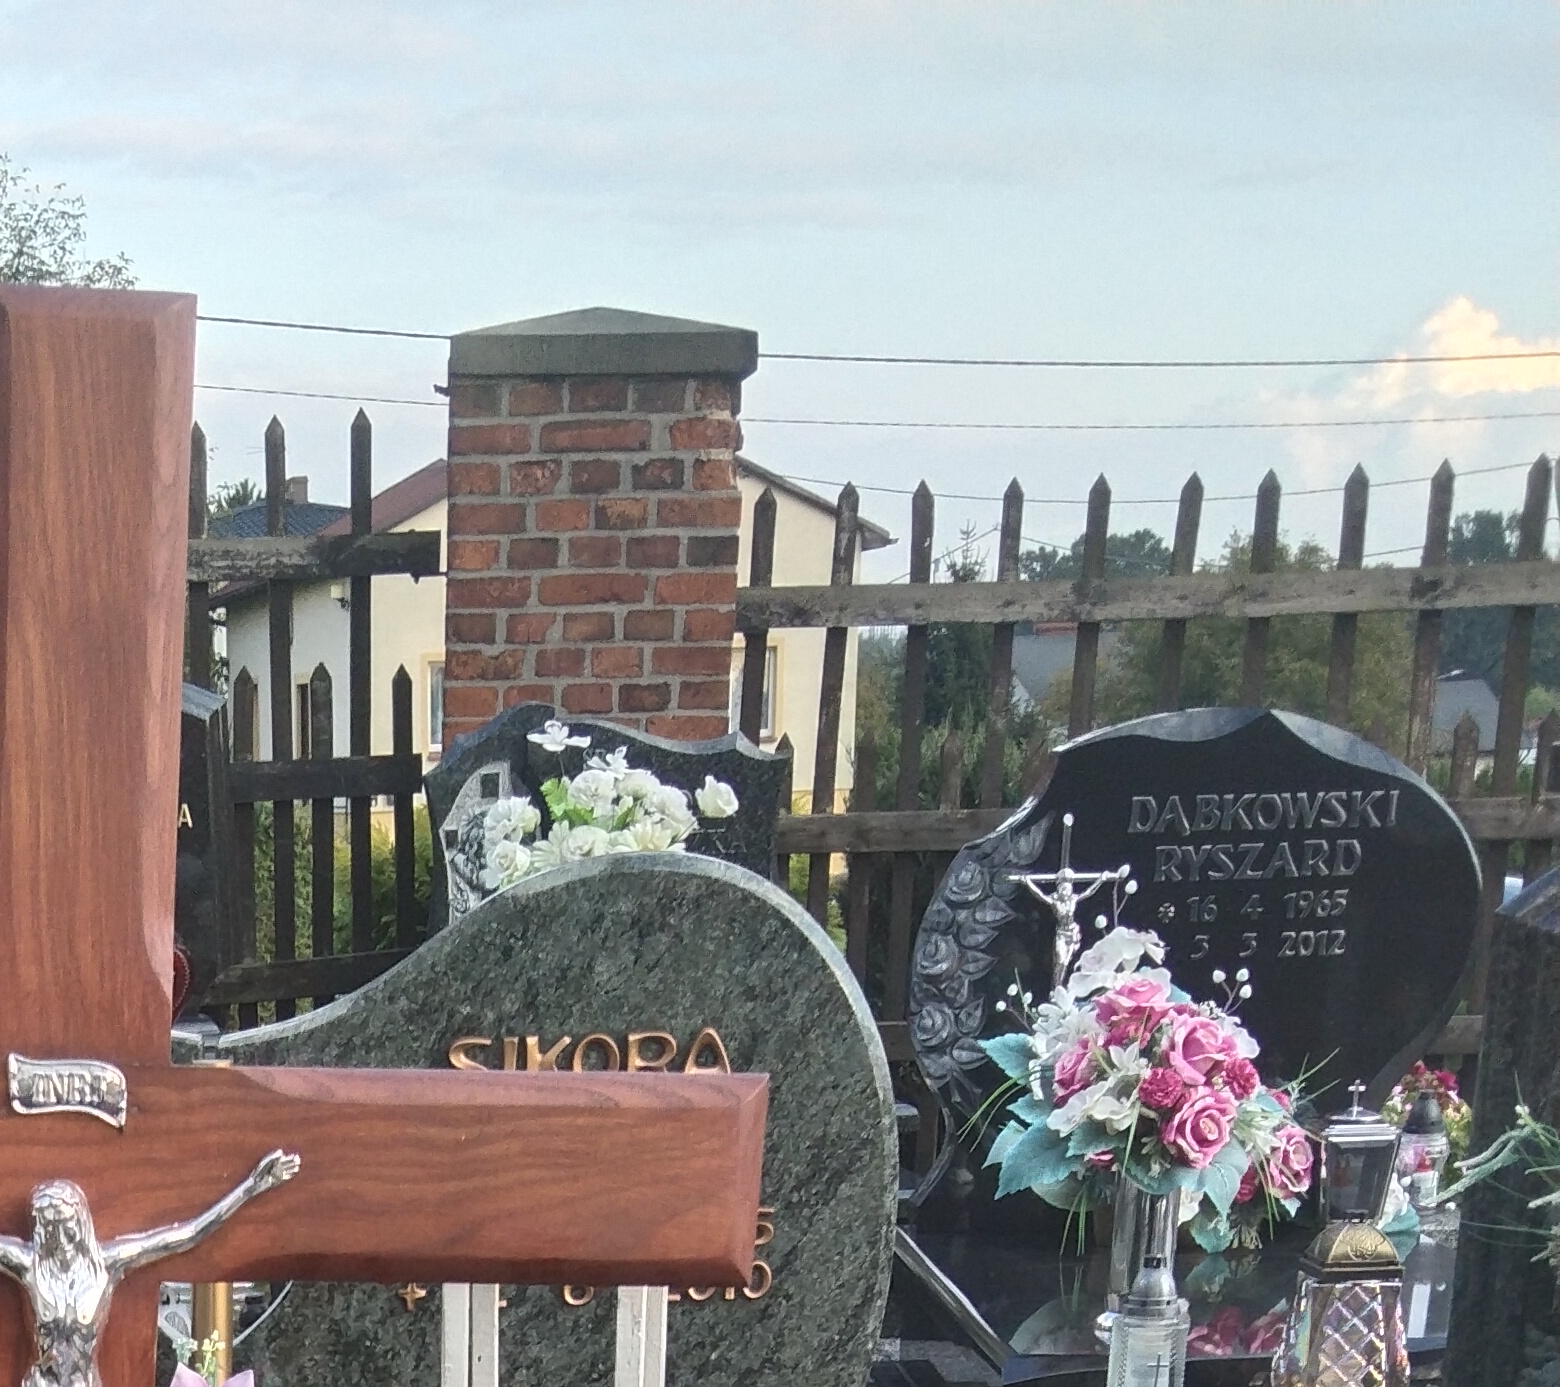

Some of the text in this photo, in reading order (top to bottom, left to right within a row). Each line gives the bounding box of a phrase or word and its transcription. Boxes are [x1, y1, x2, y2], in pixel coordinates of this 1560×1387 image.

[1153, 839, 1363, 883] RYSZARD
[1187, 894, 1218, 923] 16
[1278, 929, 1347, 958] 2012
